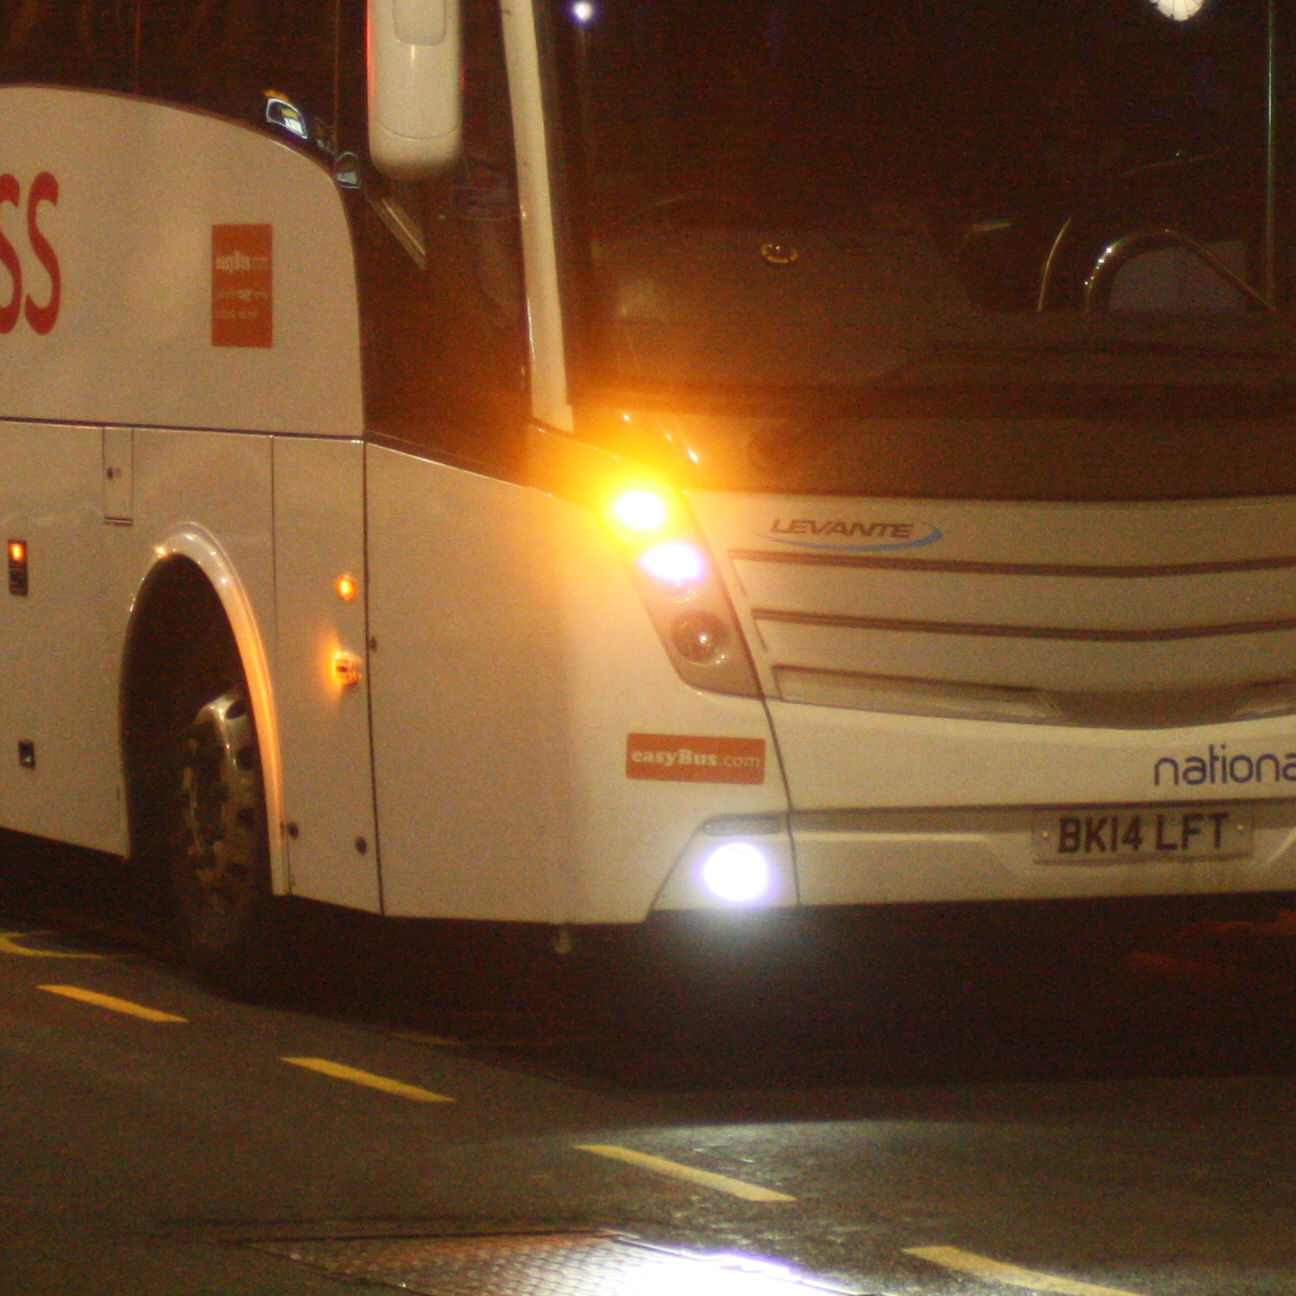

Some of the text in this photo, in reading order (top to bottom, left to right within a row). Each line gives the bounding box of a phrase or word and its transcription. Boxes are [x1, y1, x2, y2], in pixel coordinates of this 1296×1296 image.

[769, 518, 914, 539] LEVANTE
[630, 748, 761, 768] easyBus.com
[1057, 811, 1230, 854] BK14 LFT
